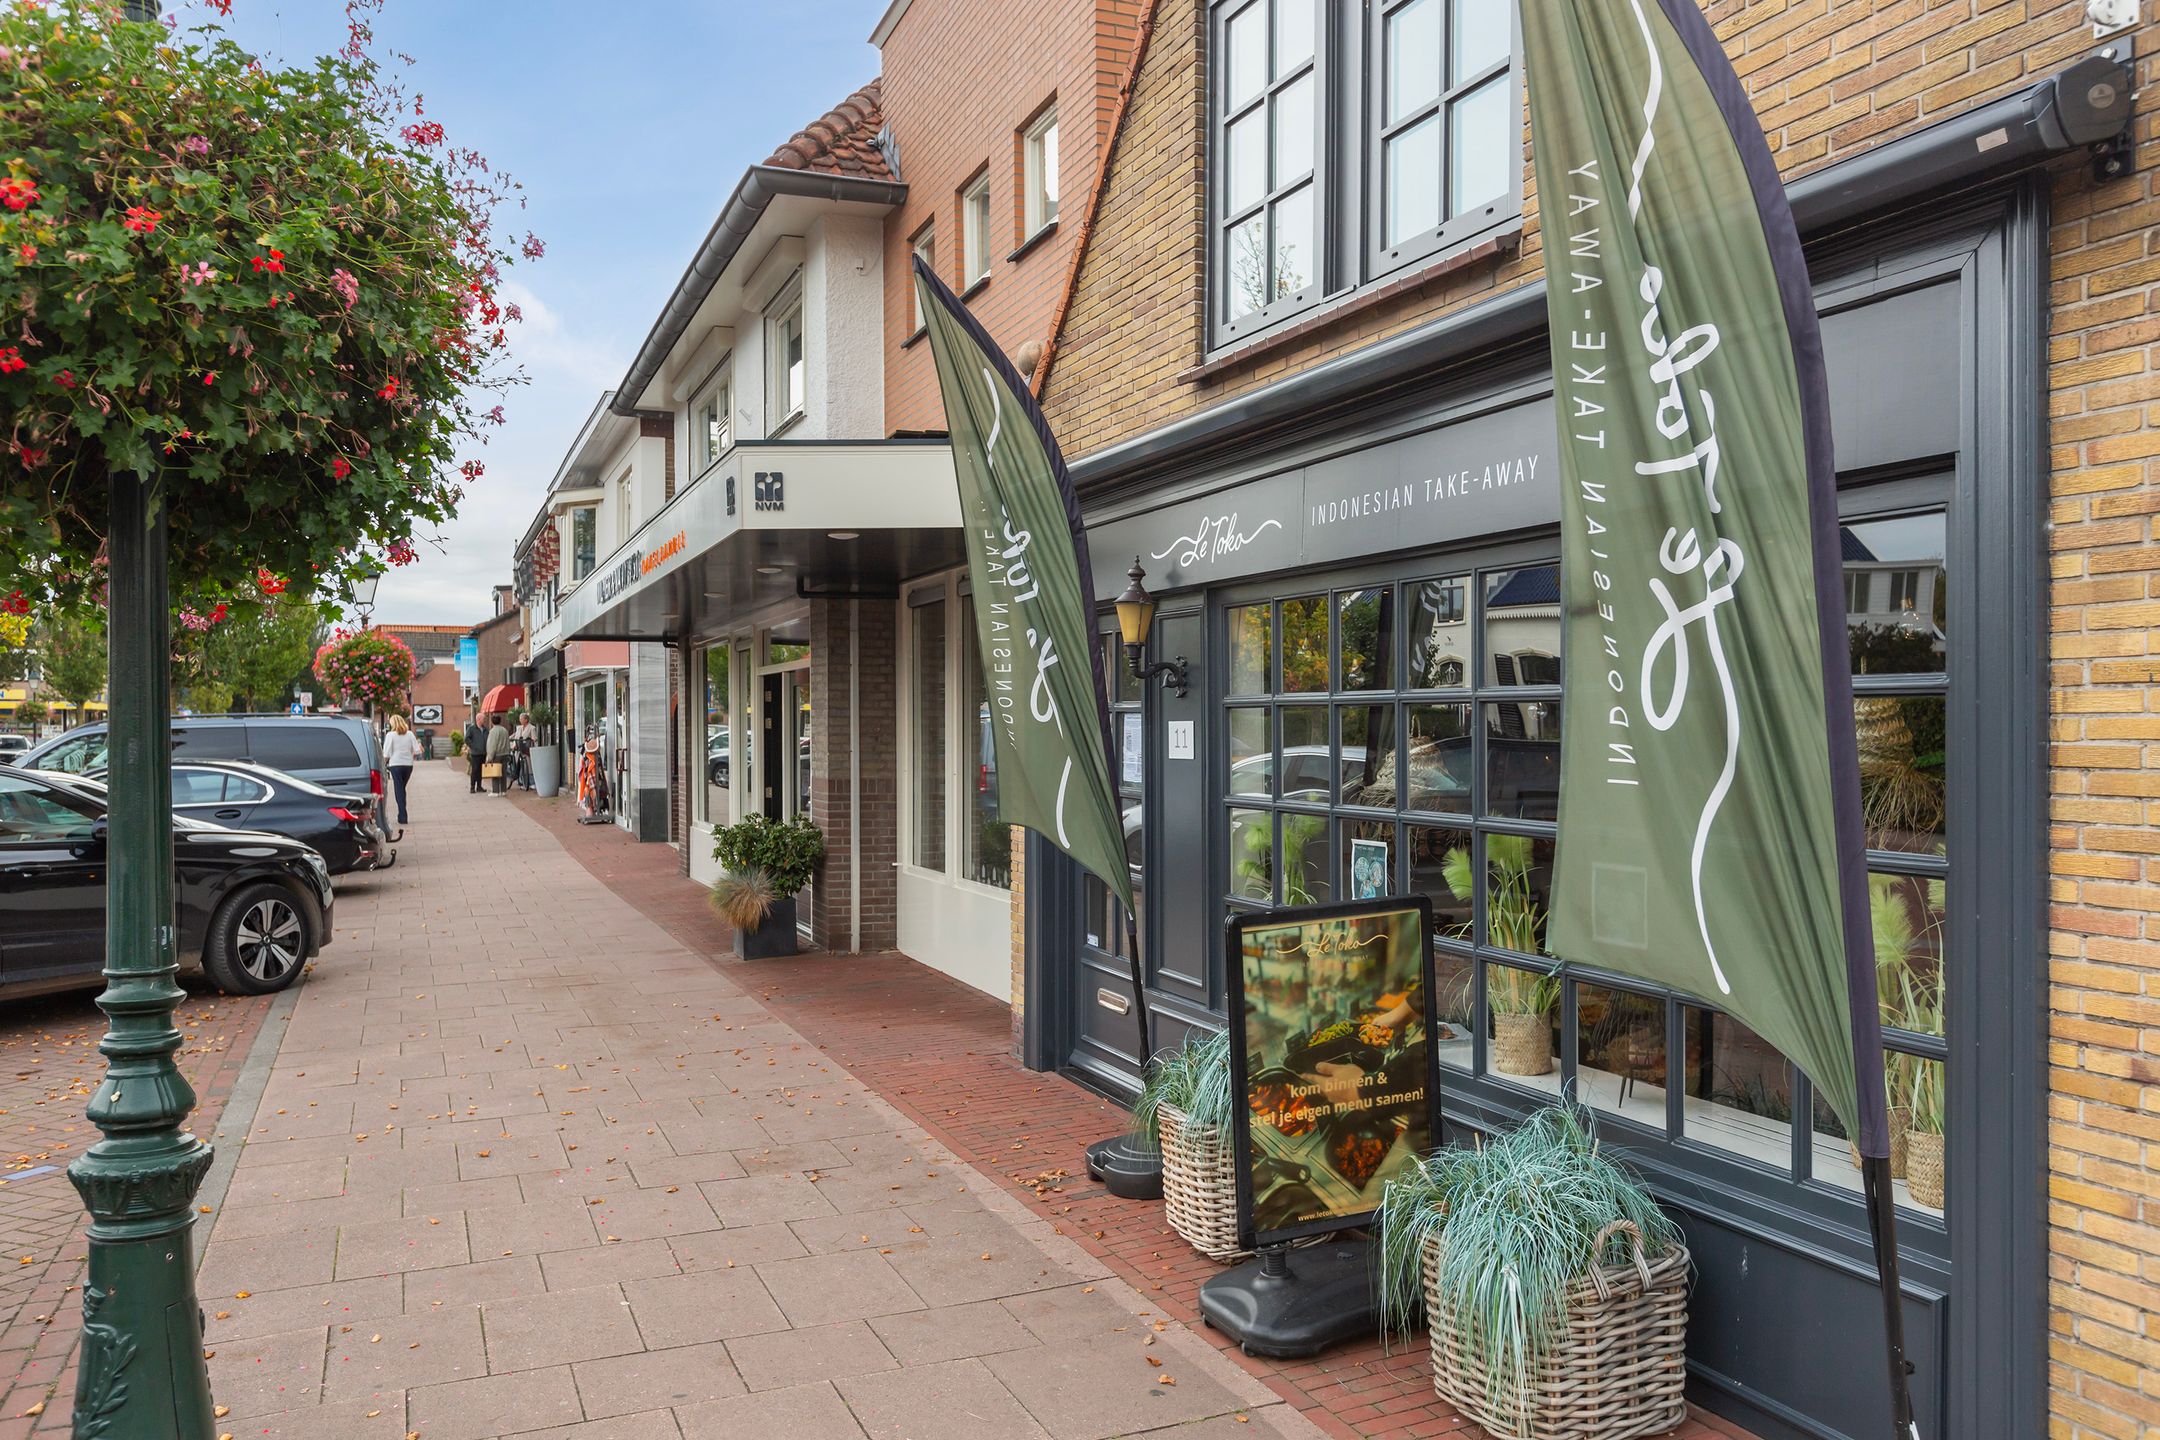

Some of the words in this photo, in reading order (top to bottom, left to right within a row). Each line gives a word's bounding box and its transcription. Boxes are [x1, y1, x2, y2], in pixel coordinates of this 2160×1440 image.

[1311, 483, 1414, 527] INDONESIAN
[1424, 454, 1539, 503] TAKE-AWAY
[755, 501, 785, 511] NVM
[1175, 728, 1188, 748] 11
[1289, 1083, 1321, 1099] kom
[1324, 1074, 1374, 1093] binnen
[1376, 1071, 1388, 1085] &
[1250, 1111, 1276, 1128] stel
[1278, 1110, 1293, 1128] je
[1295, 1102, 1332, 1123] eigen
[1333, 1098, 1374, 1115] menu
[1375, 1087, 1425, 1107] samen!
